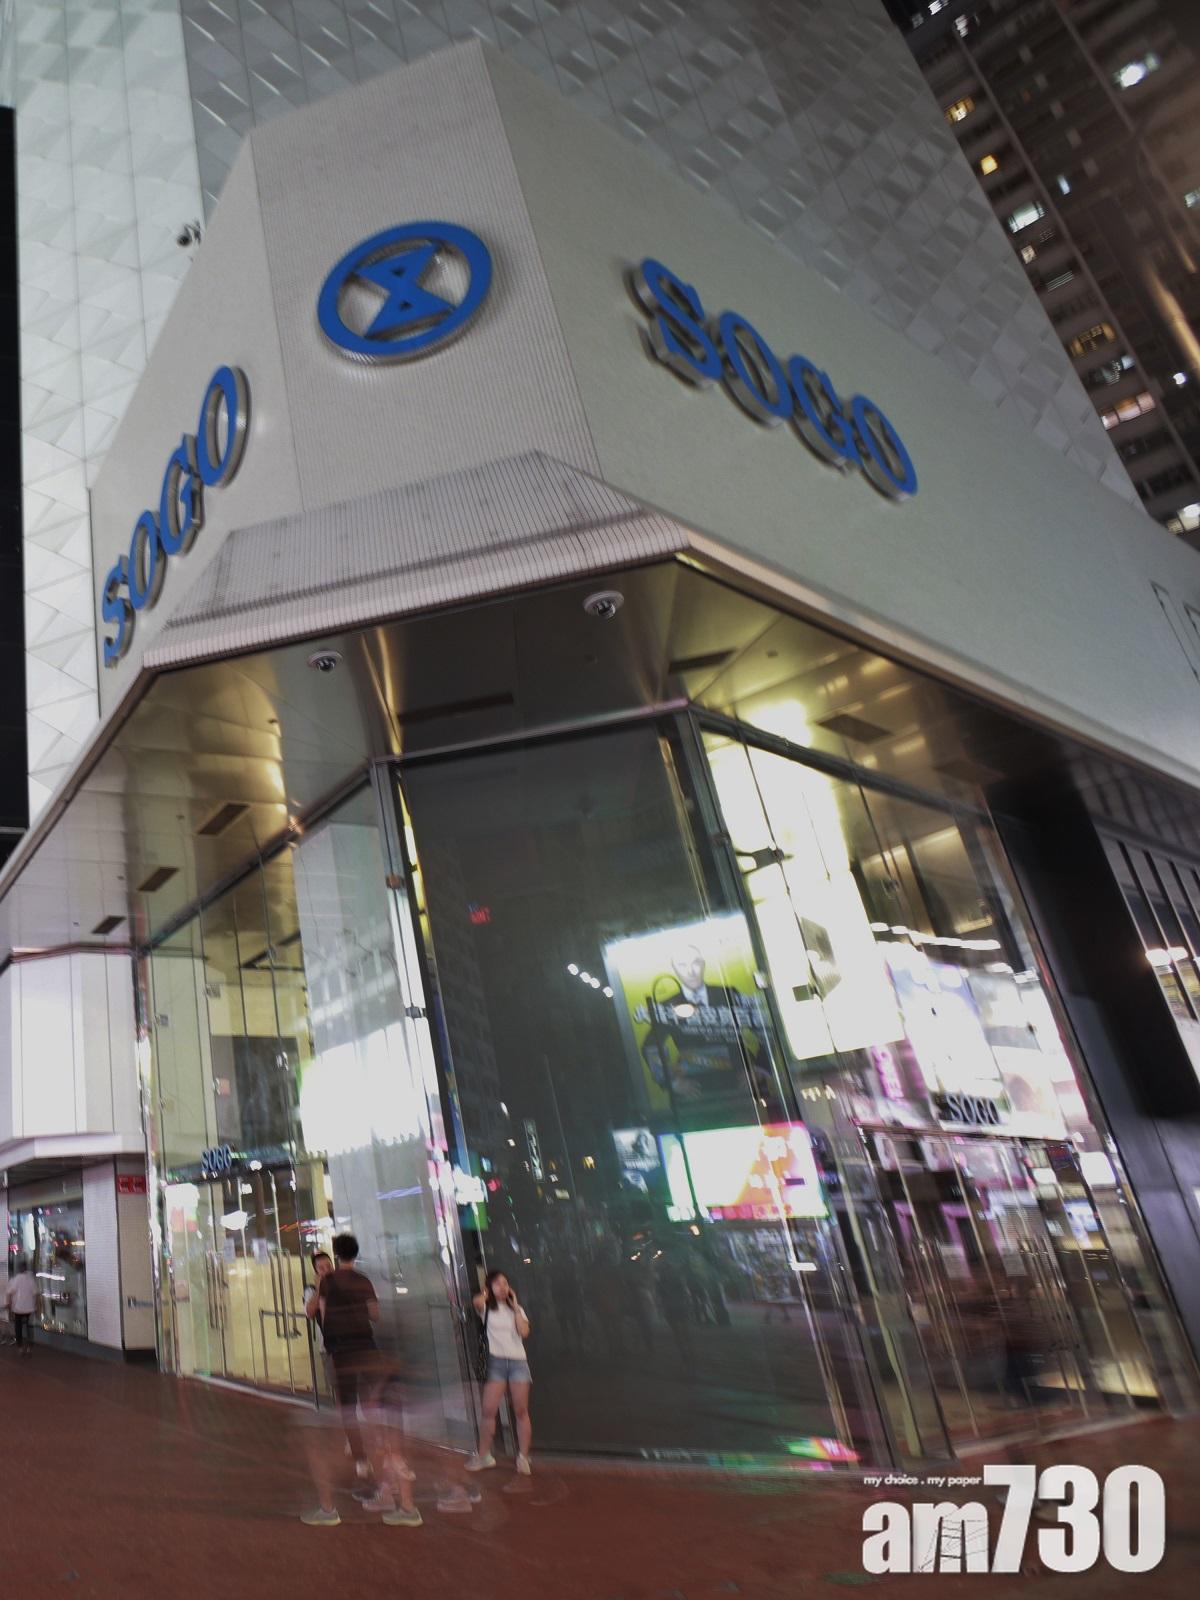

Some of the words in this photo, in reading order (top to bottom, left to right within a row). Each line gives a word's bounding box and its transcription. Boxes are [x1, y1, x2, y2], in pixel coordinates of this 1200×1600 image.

[635, 256, 919, 501] SOGO
[102, 364, 250, 668] SOGO
[945, 1092, 1002, 1125] SOGO
